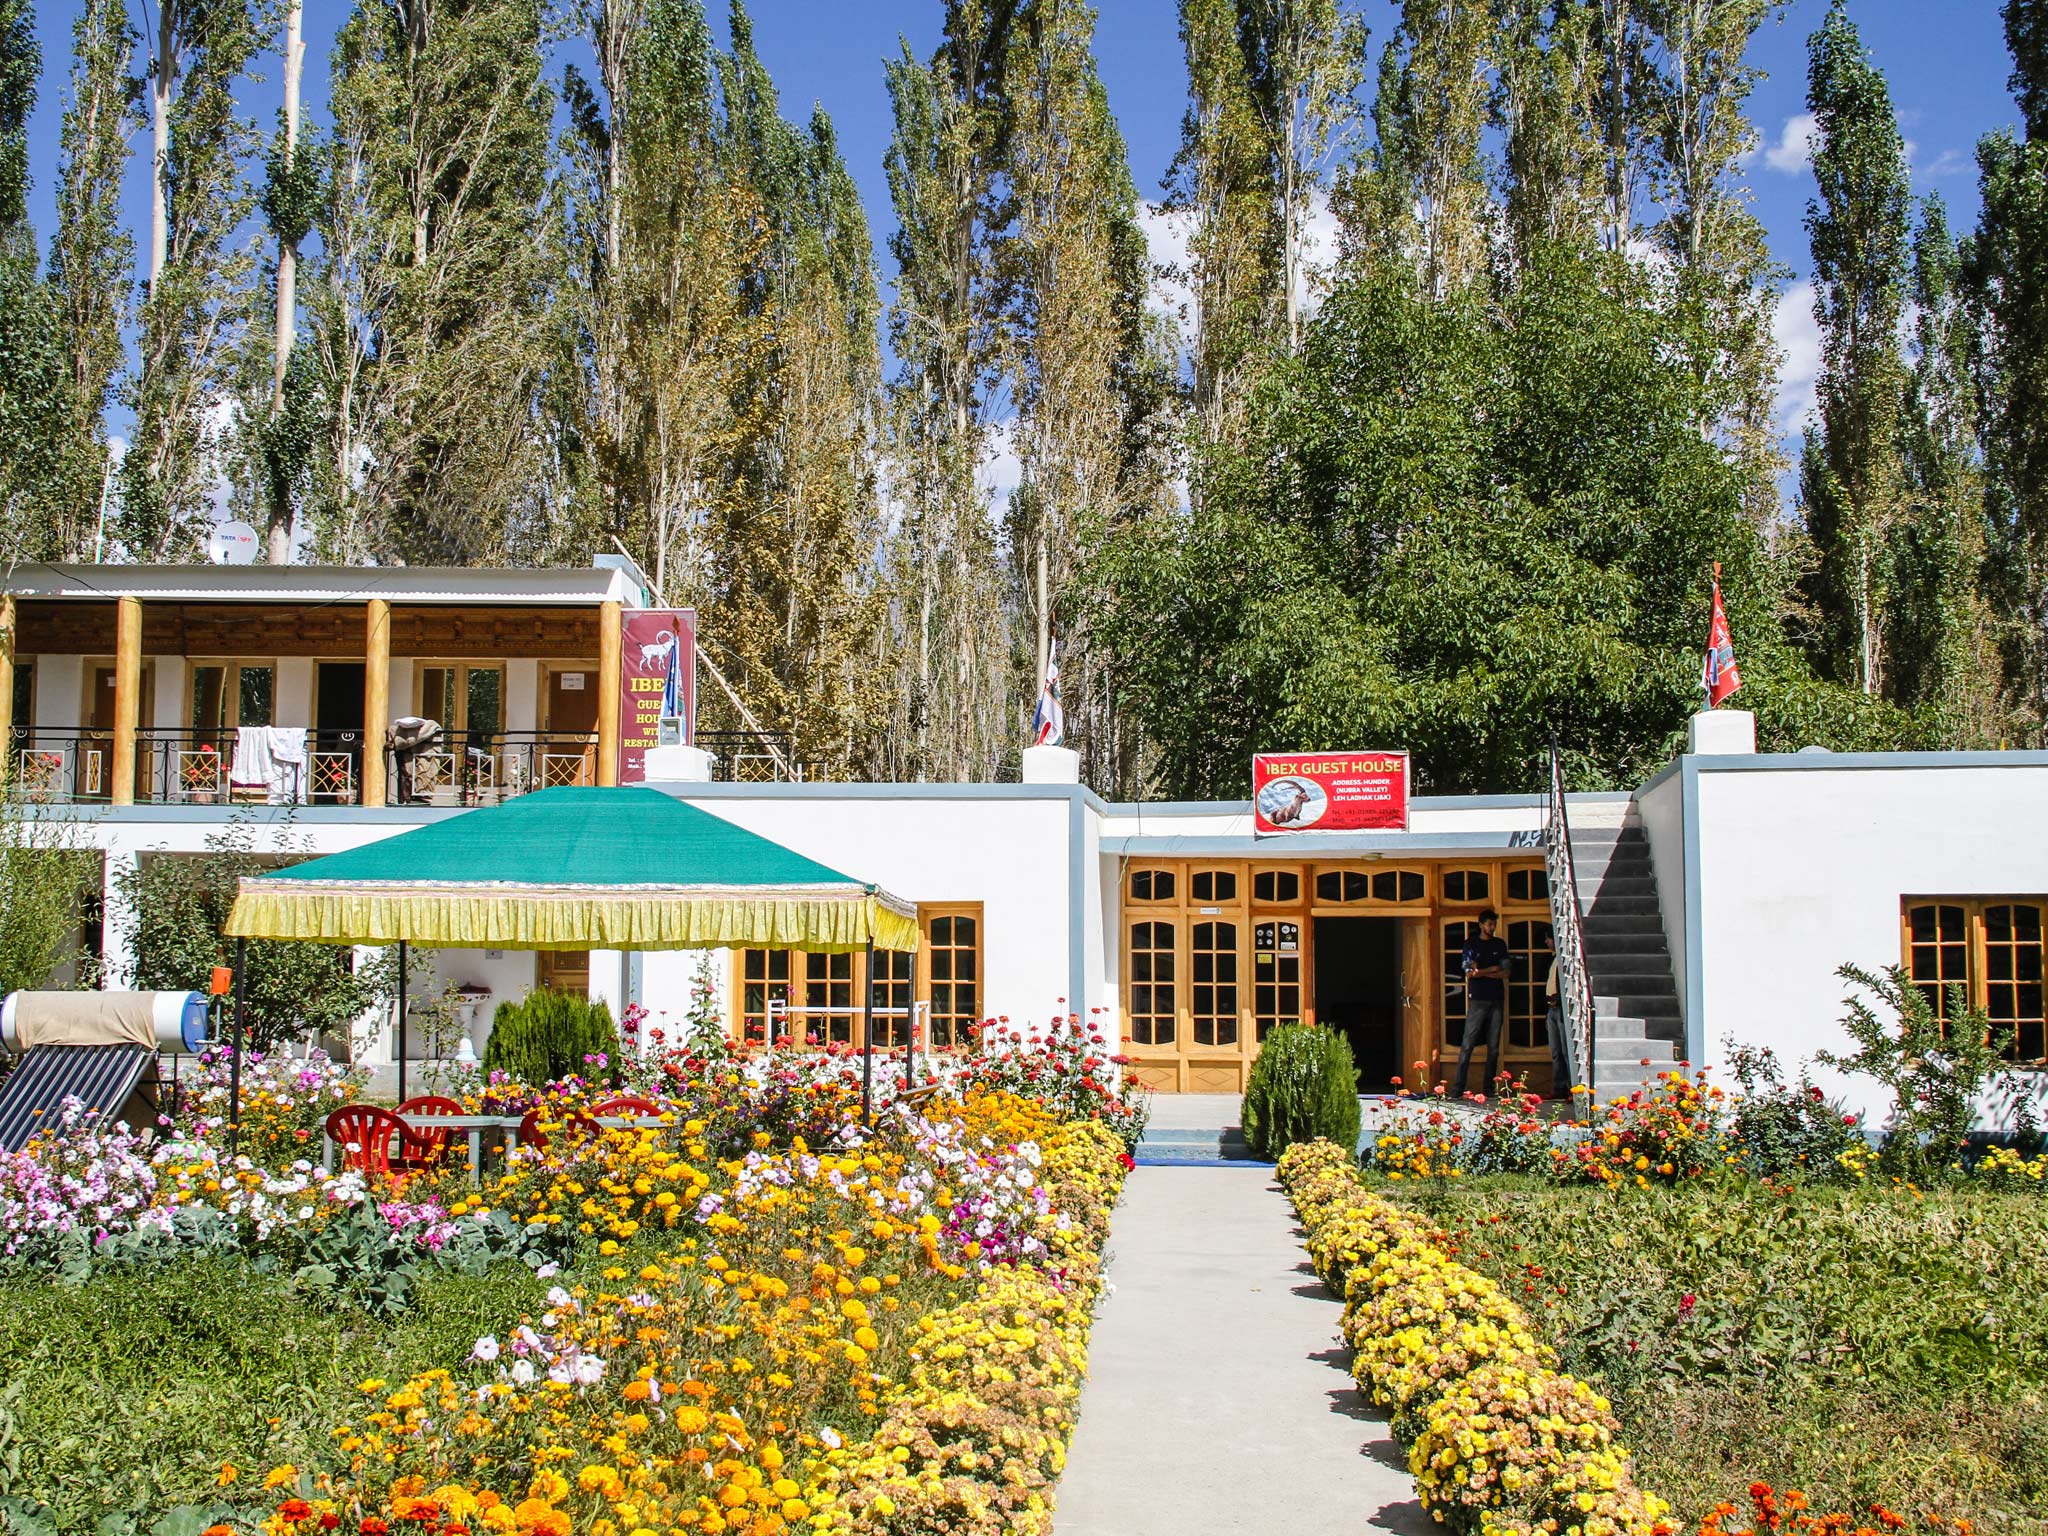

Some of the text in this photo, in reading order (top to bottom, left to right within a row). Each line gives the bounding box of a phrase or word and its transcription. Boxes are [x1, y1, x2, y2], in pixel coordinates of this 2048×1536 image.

[630, 677, 665, 692] IBE
[637, 699, 661, 710] GUE
[635, 713, 660, 724] HOU
[642, 727, 658, 736] WIT
[1266, 760, 1402, 775] IBEX GUEST HOUSE
